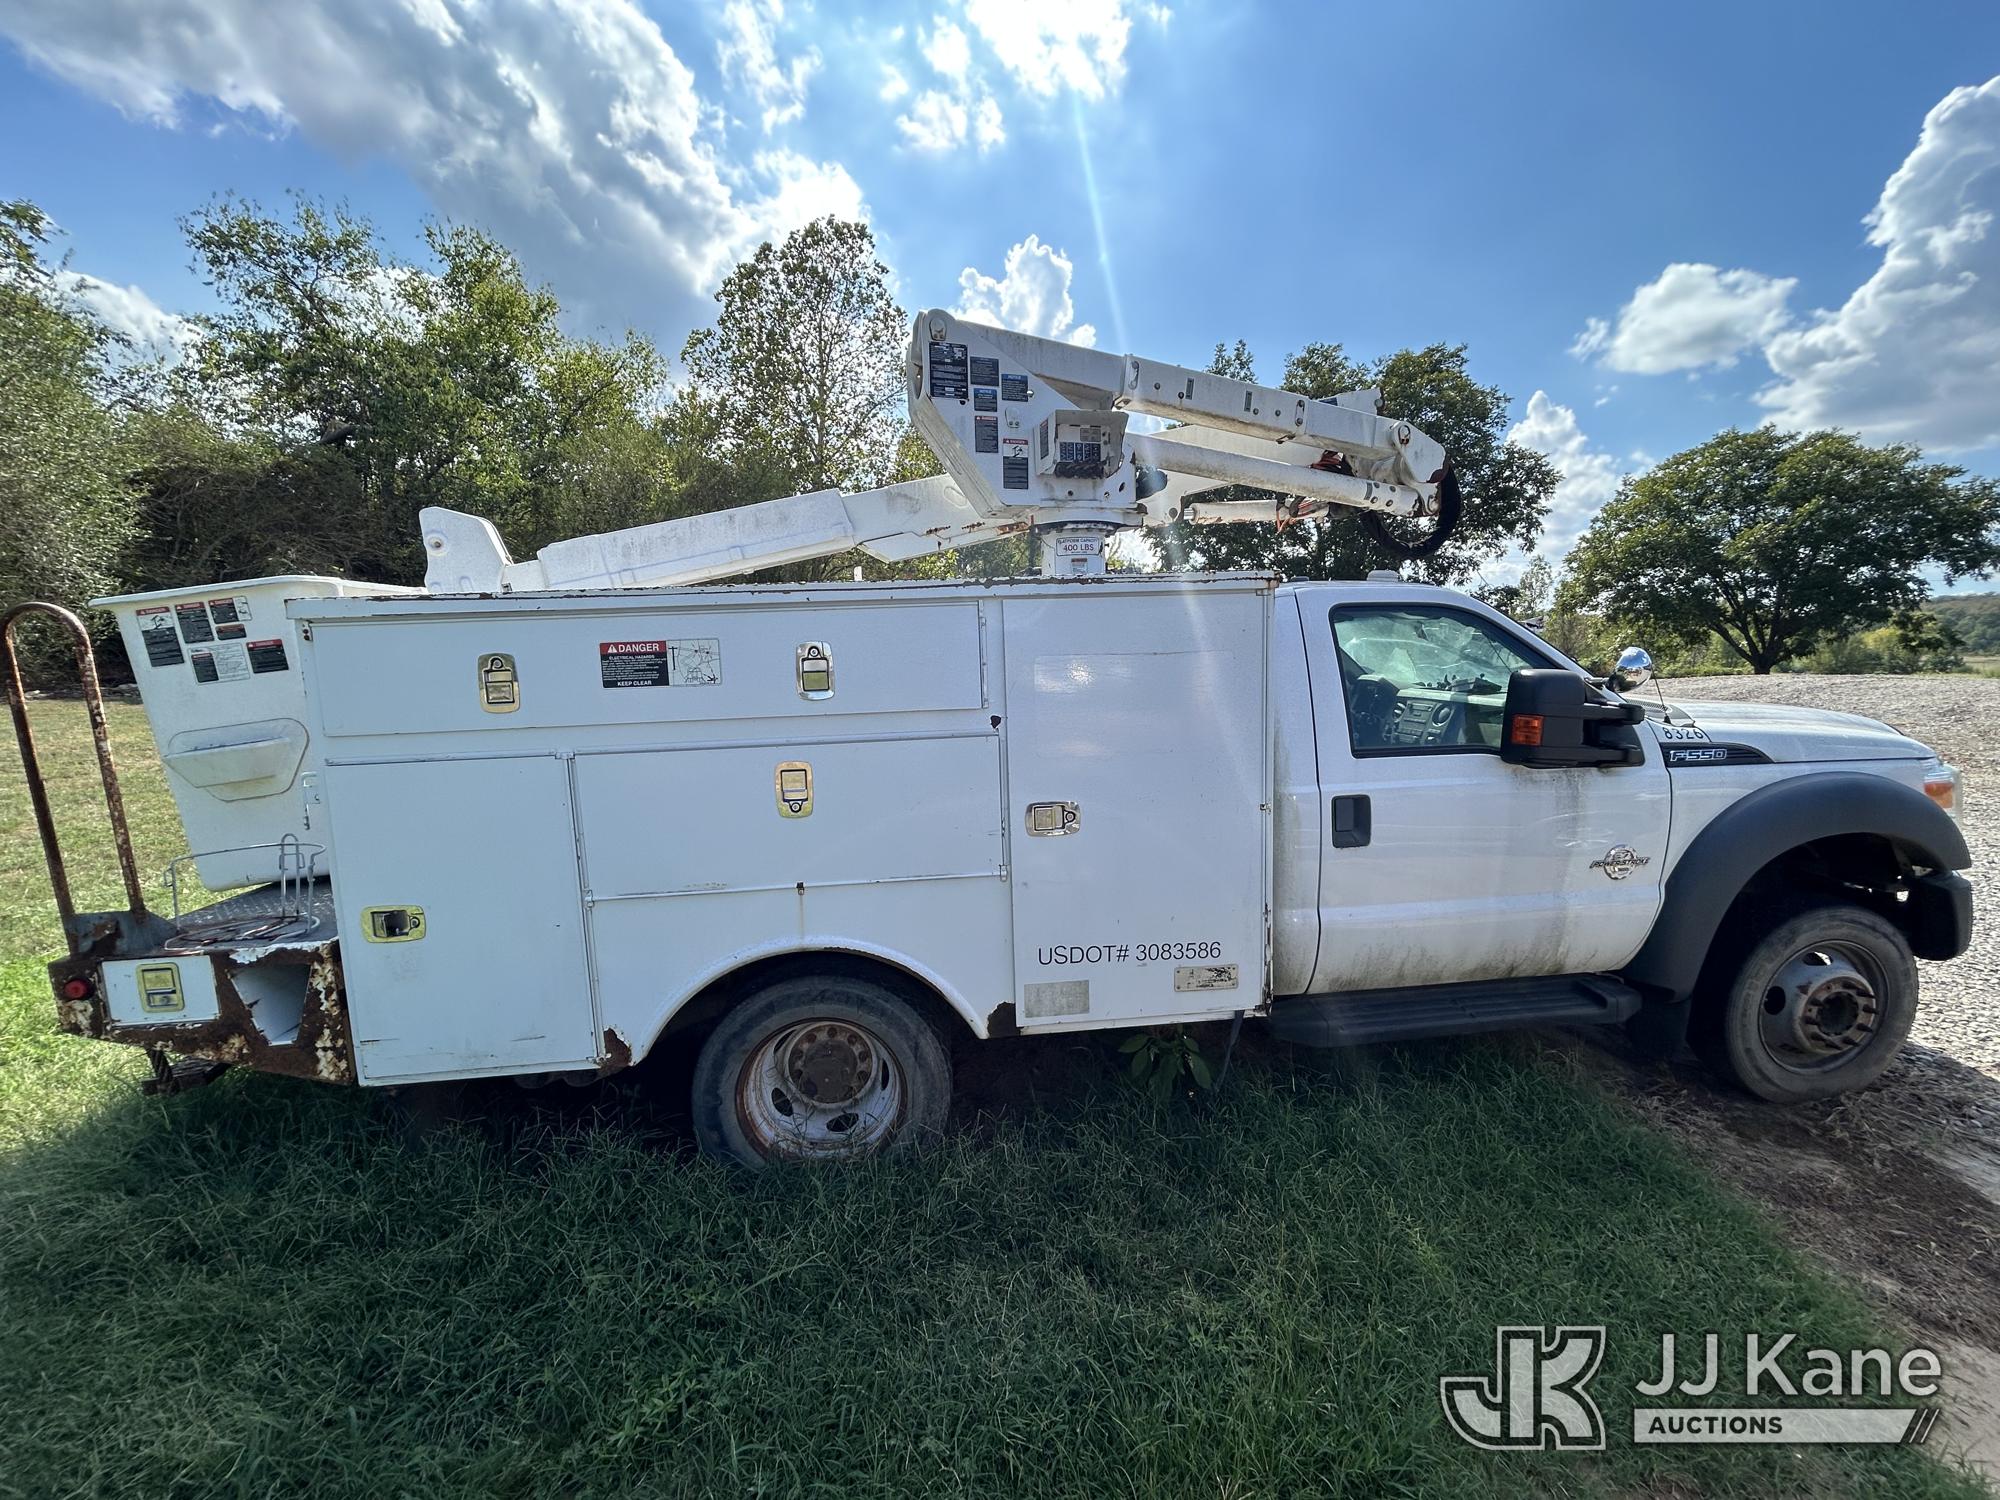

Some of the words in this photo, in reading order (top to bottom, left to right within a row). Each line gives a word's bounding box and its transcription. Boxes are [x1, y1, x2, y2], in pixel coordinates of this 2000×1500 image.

[1081, 543, 1095, 551] LBS
[618, 643, 660, 653] DANGER
[1662, 726, 1704, 740] 8326
[1038, 944, 1130, 966] USDOT#
[1135, 941, 1222, 962] 3083586
